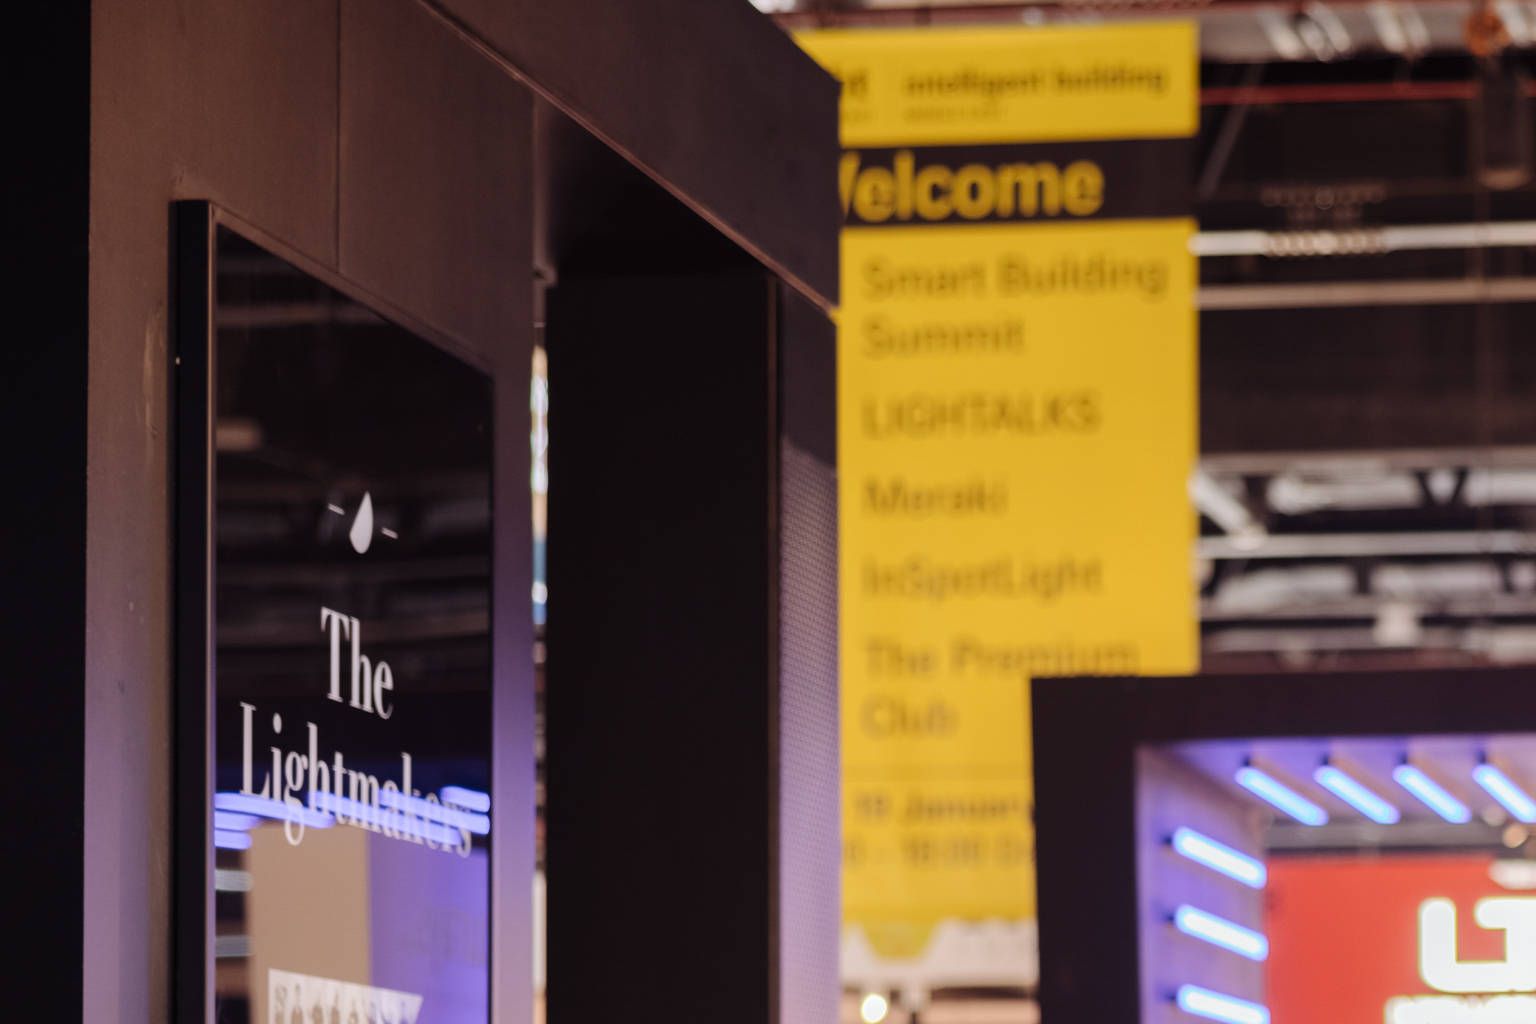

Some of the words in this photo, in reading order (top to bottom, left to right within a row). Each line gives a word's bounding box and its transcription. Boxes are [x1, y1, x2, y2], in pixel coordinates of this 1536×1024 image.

[1053, 62, 1168, 96] building
[862, 256, 986, 298] Smart
[997, 252, 1169, 303] Building
[863, 314, 1025, 358] Summit
[864, 477, 1008, 516] Meraki
[321, 606, 394, 719] The
[864, 637, 938, 674] The
[950, 635, 1138, 676] Premium
[863, 694, 958, 738] Club
[240, 701, 473, 858] Lightmakers
